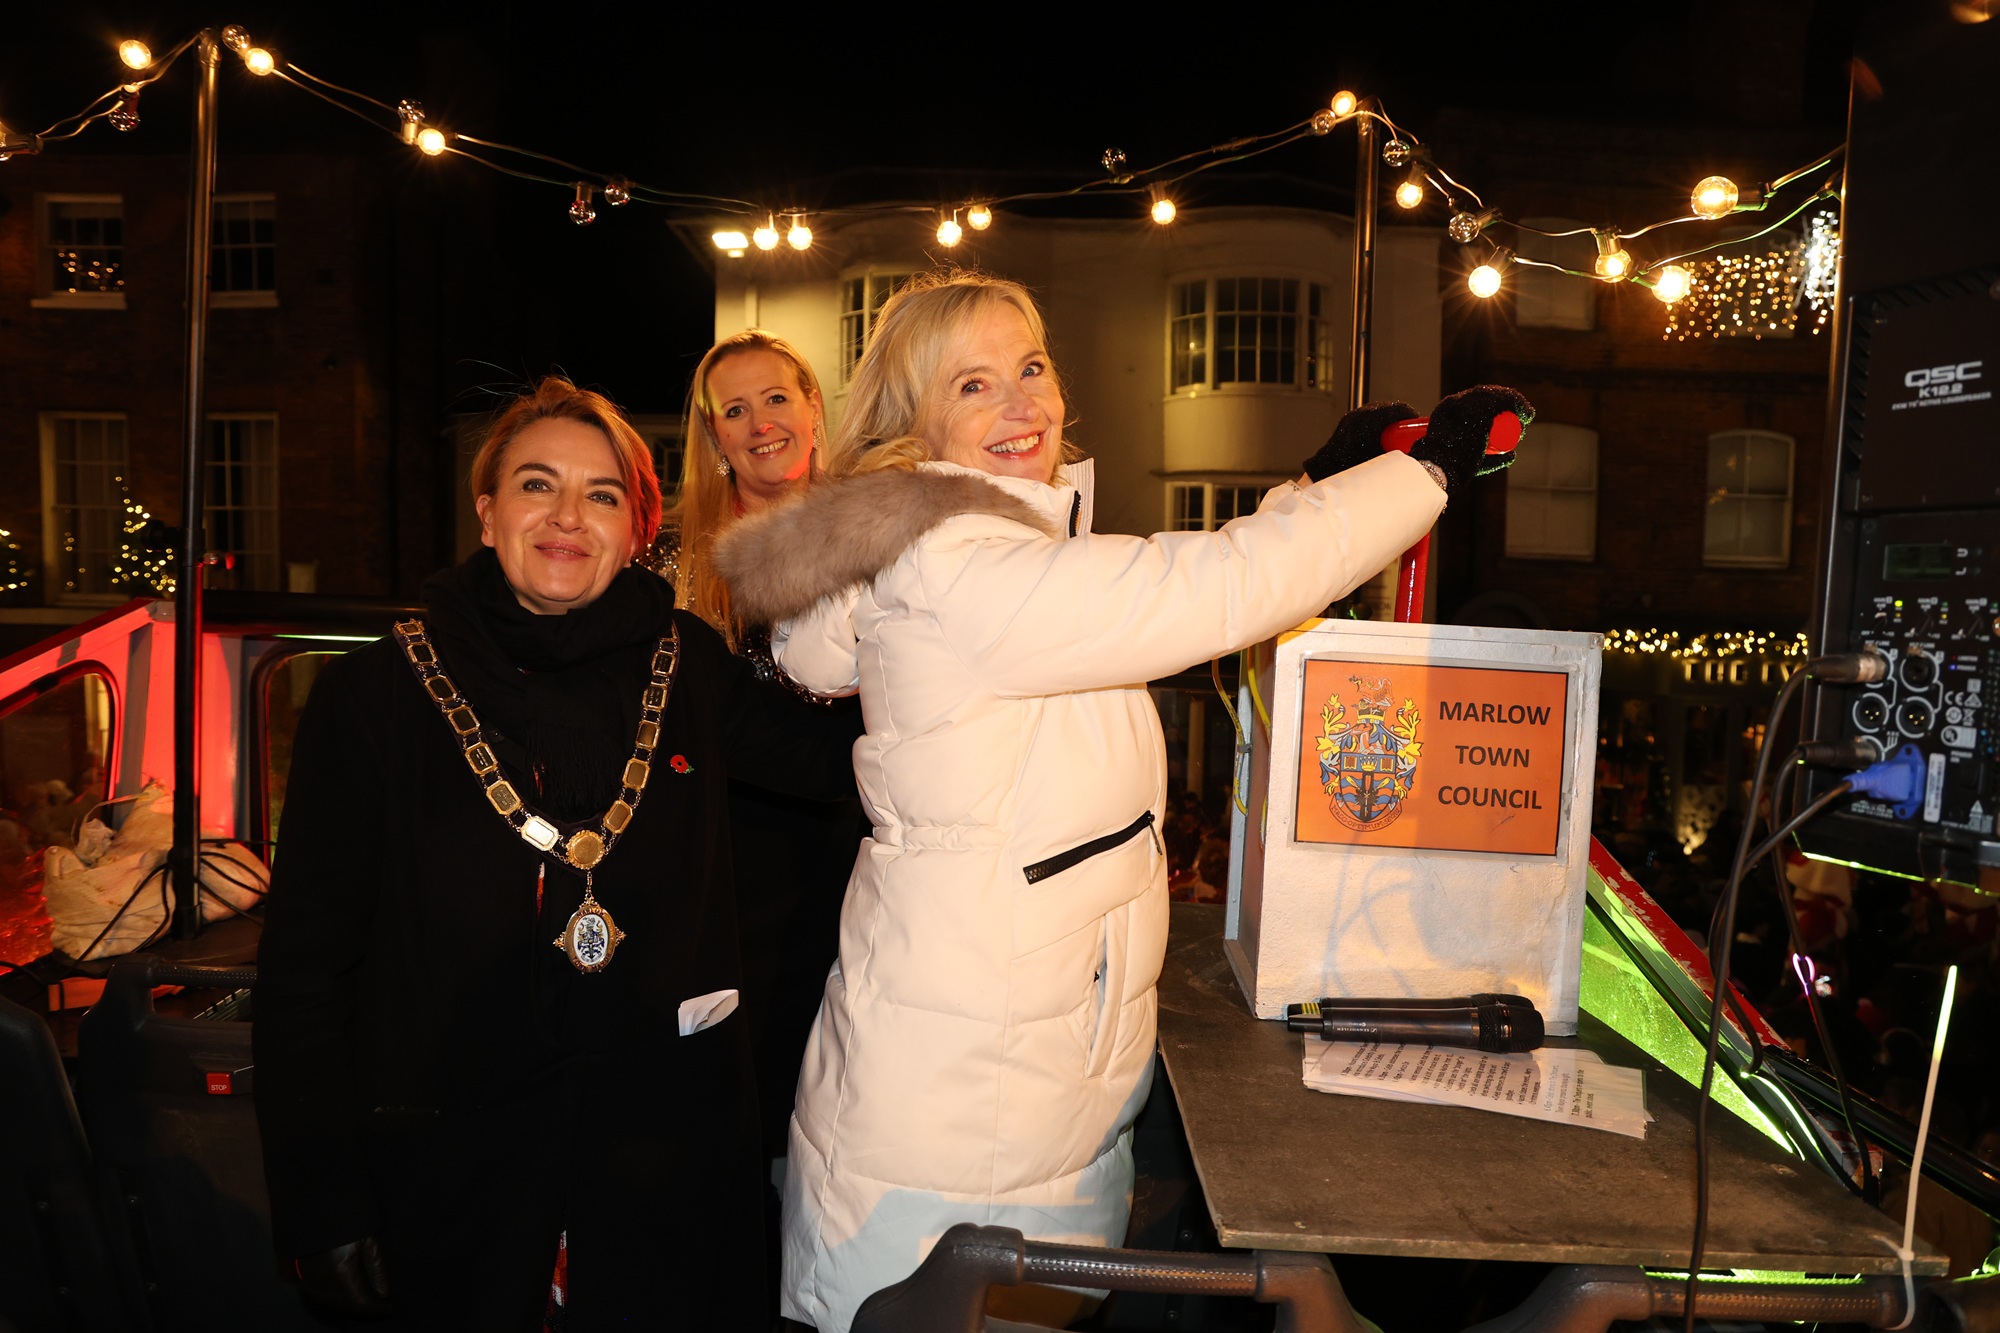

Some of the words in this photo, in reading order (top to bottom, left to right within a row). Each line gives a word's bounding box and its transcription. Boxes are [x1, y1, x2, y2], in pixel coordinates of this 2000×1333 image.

[1904, 360, 1983, 388] QSC
[1439, 701, 1551, 725] MARLOW
[1455, 745, 1530, 768] TOWN
[1438, 786, 1542, 809] COUNCIL
